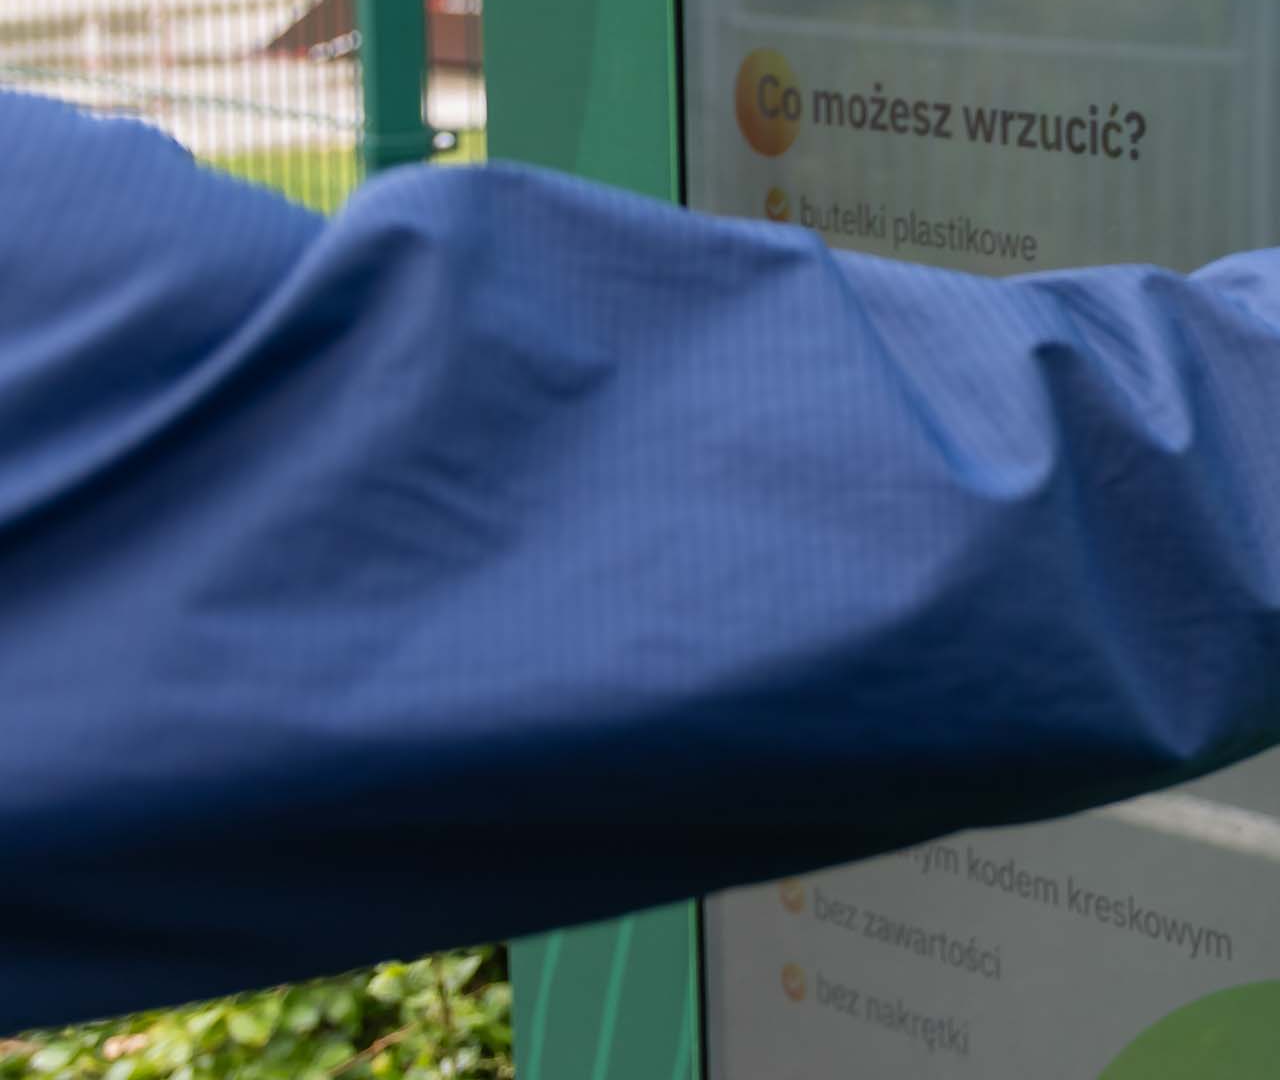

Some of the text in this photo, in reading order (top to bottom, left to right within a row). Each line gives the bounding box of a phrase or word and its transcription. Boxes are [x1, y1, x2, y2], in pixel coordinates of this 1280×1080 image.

[758, 74, 1147, 160] Co możesz wrzucić?
[800, 197, 1037, 262] butelki plastikowe
[815, 887, 1002, 980] bez zawartości
[967, 846, 1059, 906] kodem
[1068, 877, 1233, 961] kreskowym
[816, 970, 969, 1056] bez nakrętki
